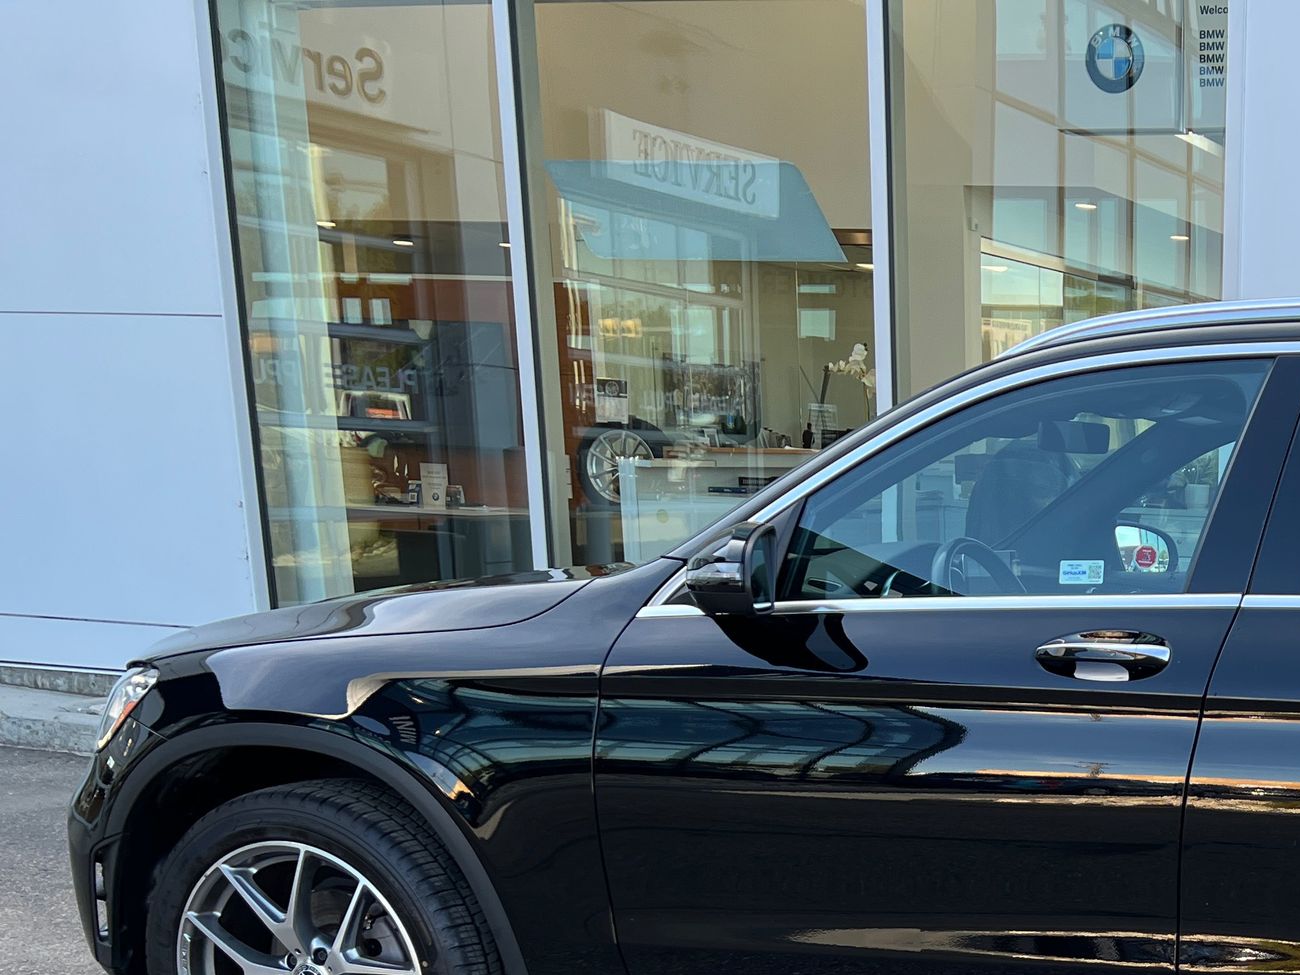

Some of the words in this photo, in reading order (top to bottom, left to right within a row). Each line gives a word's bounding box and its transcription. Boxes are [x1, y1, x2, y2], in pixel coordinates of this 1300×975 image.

[1199, 30, 1225, 40] BMW
[1199, 42, 1225, 52] BMW
[1199, 54, 1225, 63] BMW
[1199, 66, 1225, 75] BMW
[1199, 78, 1225, 87] BMW
